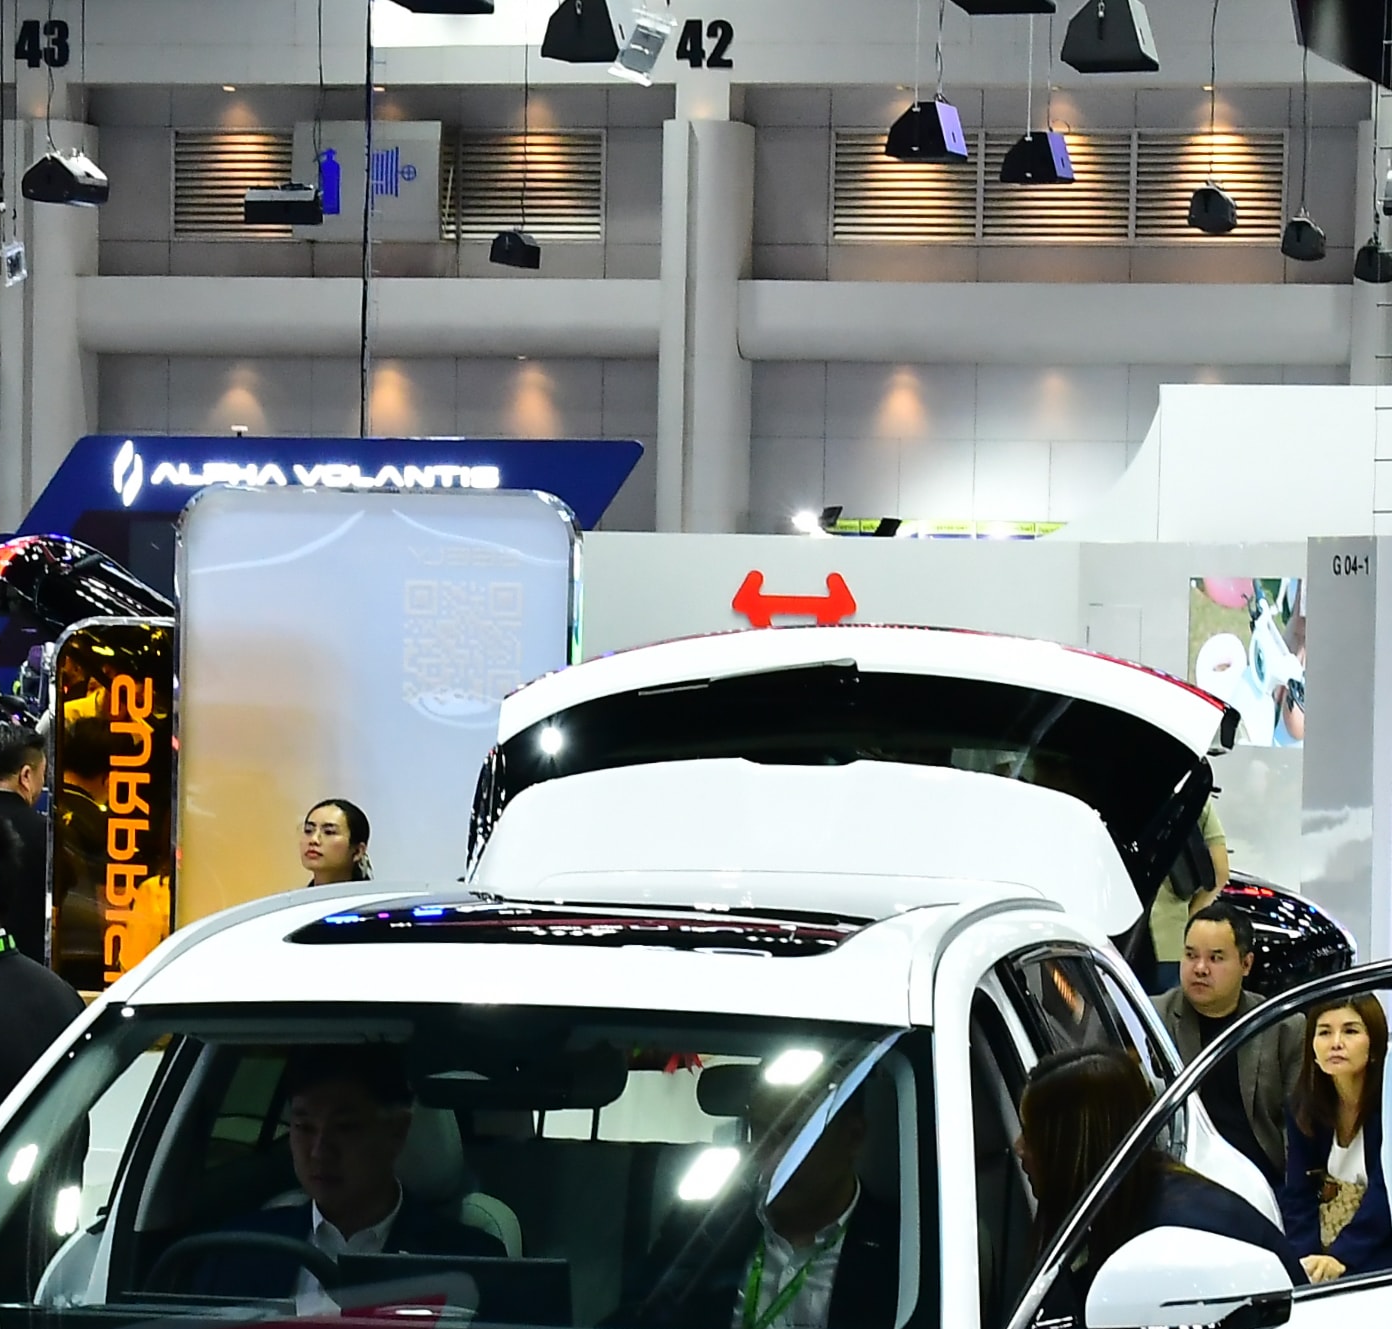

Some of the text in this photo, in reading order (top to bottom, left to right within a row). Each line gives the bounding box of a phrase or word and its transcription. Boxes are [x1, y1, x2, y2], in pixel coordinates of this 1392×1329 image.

[14, 19, 70, 68] 43
[676, 19, 734, 69] 42
[150, 461, 501, 489] ALPHA VOLANTIS
[1332, 554, 1370, 576] G 04-1
